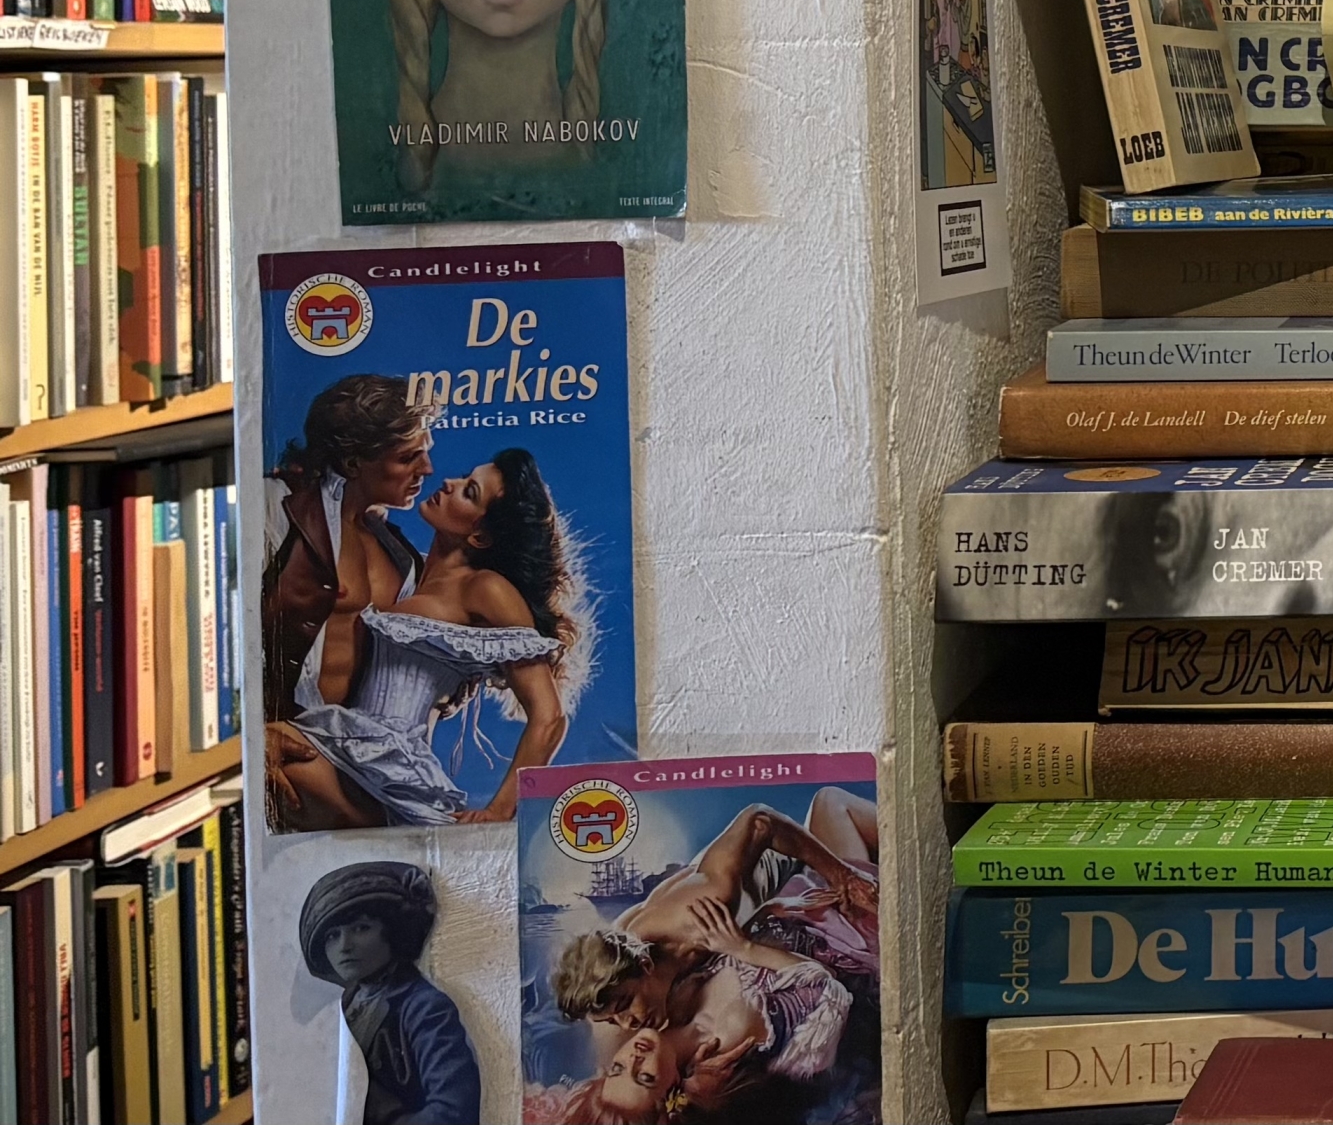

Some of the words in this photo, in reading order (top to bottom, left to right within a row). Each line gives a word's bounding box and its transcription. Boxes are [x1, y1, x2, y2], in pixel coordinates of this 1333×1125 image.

[389, 122, 508, 145] VLADIMIR
[524, 119, 641, 143] NABOKOV
[368, 260, 543, 279] Candlelight
[466, 297, 537, 347] De
[1074, 344, 1146, 366] Theun
[1149, 344, 1174, 365] de
[1175, 344, 1251, 365] Winter
[405, 350, 600, 407] markies
[420, 412, 519, 430] Patricia
[530, 410, 586, 424] Rice
[634, 764, 804, 783] Candlelight
[1060, 910, 1188, 984] De
